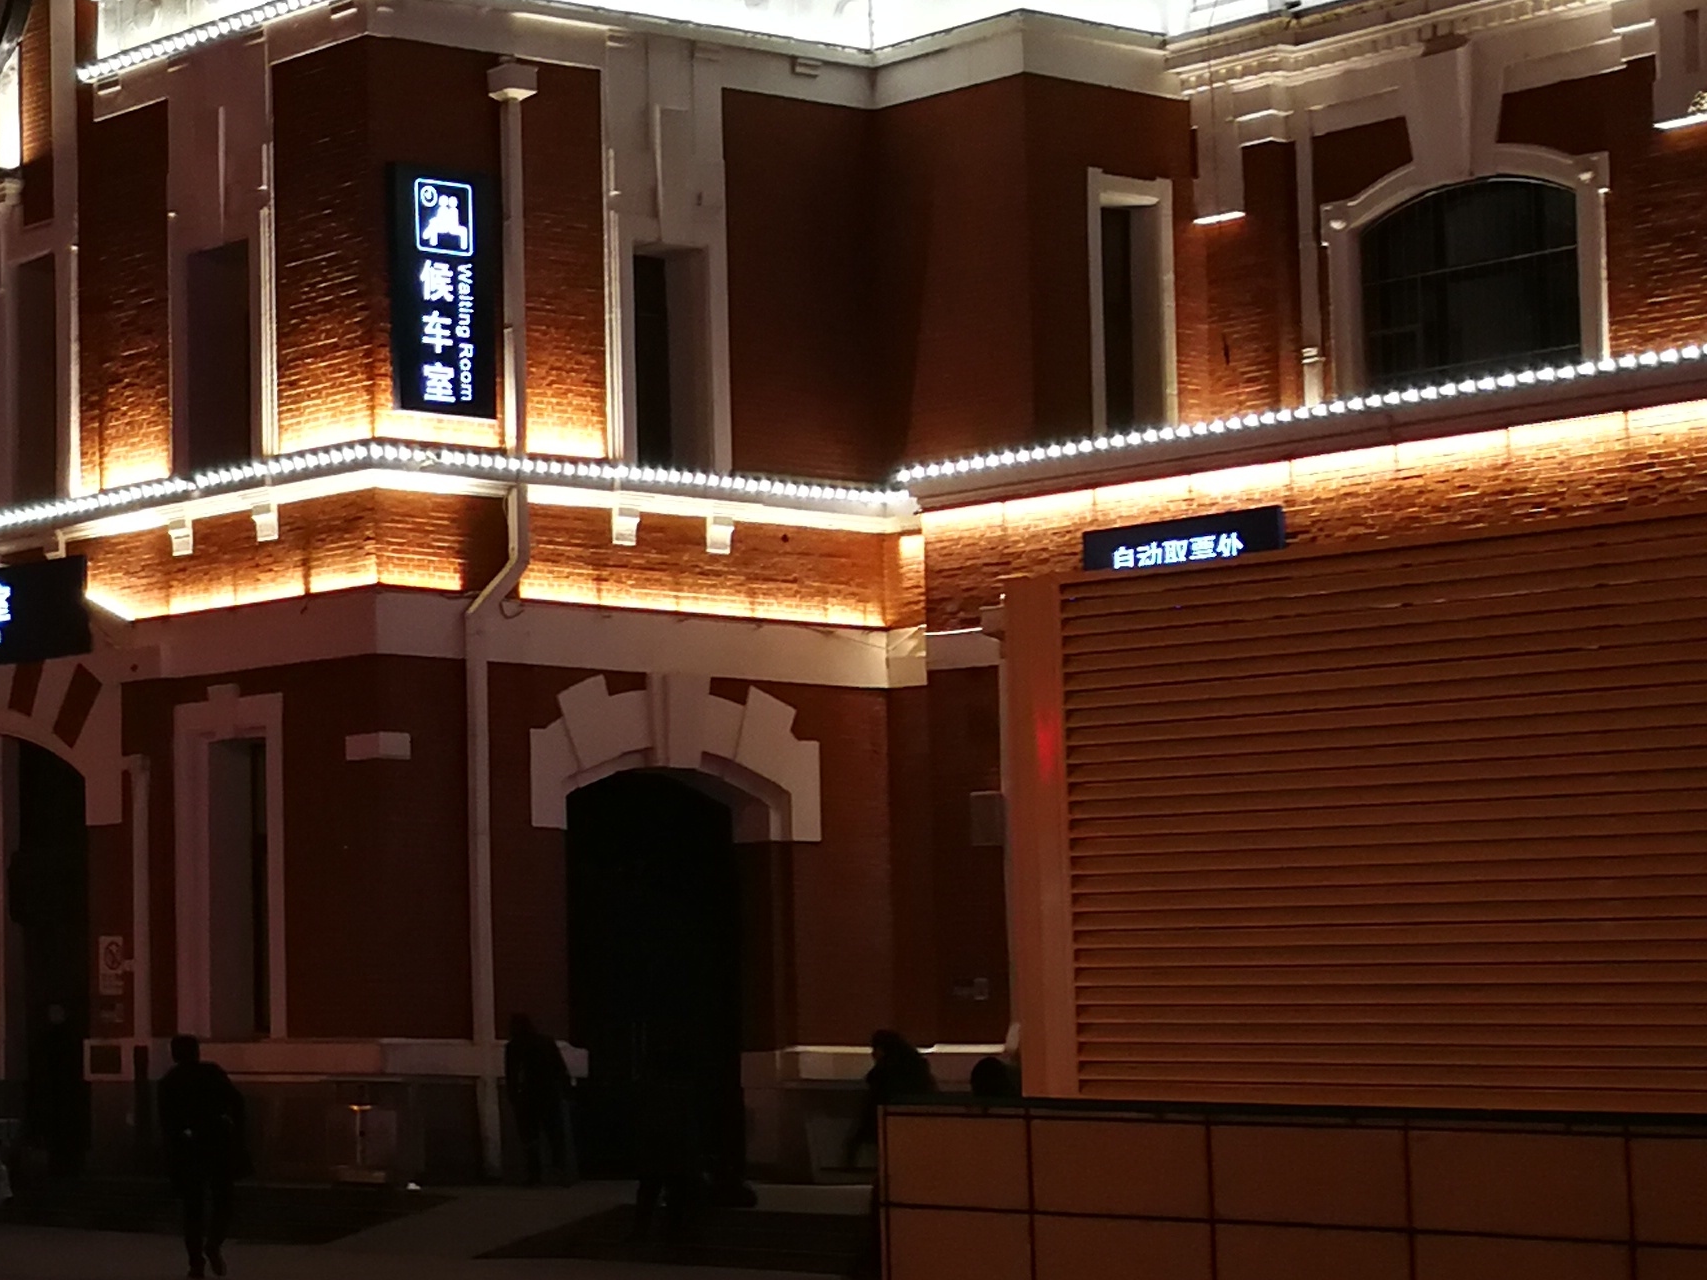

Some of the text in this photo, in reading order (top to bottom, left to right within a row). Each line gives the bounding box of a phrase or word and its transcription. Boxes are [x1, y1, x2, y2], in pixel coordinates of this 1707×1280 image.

[419, 259, 456, 404] 候车室
[455, 263, 475, 402] Waiting Room
